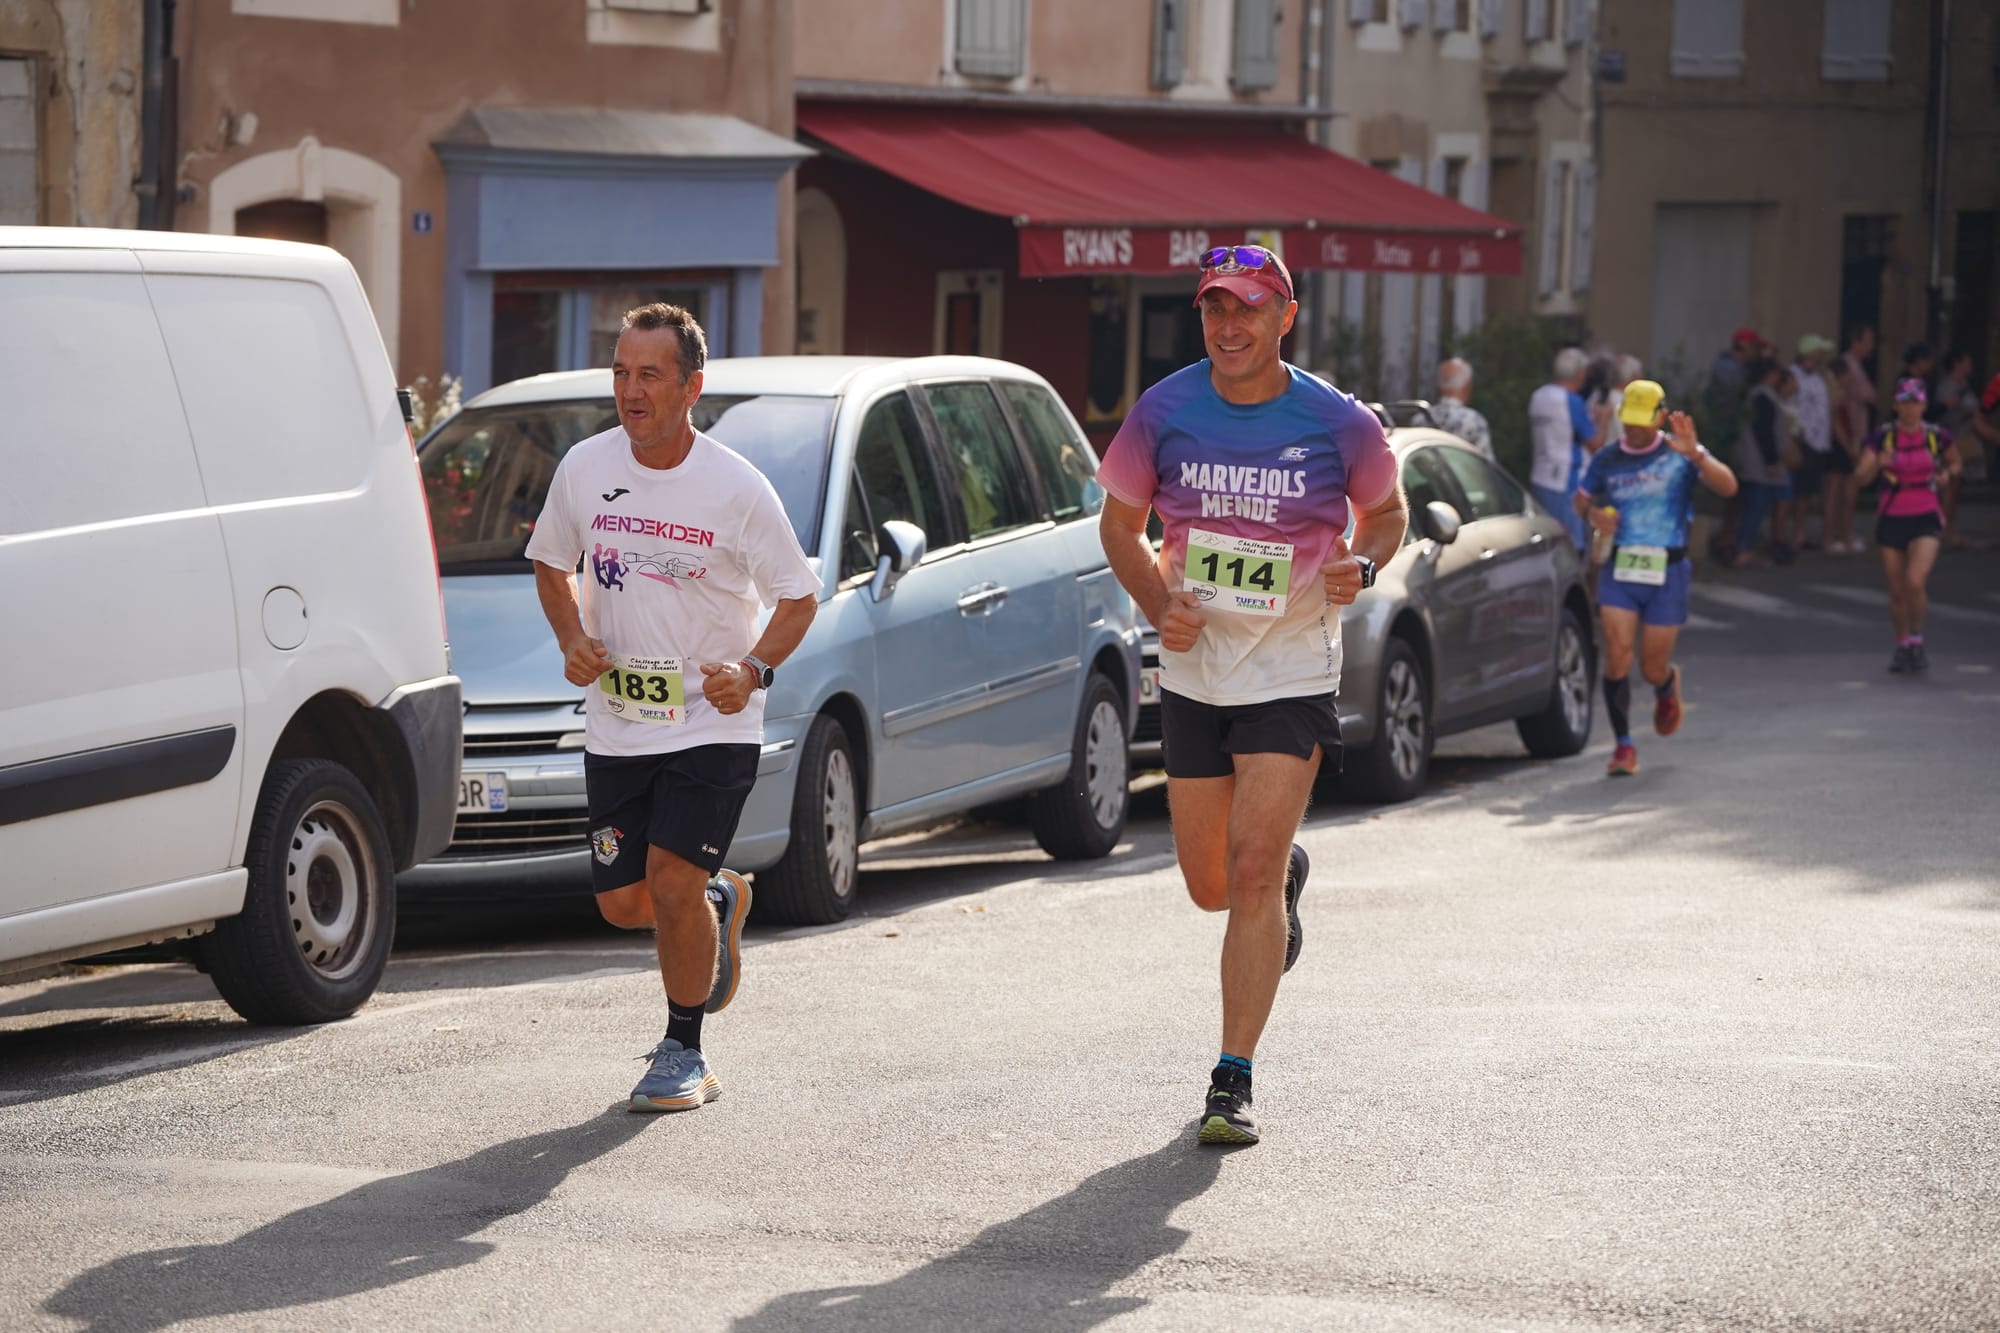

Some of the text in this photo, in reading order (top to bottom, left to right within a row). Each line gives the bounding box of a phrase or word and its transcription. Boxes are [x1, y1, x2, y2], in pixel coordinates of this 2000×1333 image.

[1063, 228, 1210, 267] RYAN'S BAR
[1180, 462, 1306, 498] MARVEJOLS
[1201, 492, 1280, 523] MENDE
[591, 514, 714, 547] MENDEKIDEN
[1201, 552, 1275, 591] 114
[1627, 554, 1652, 569] 75
[608, 669, 669, 703] 183
